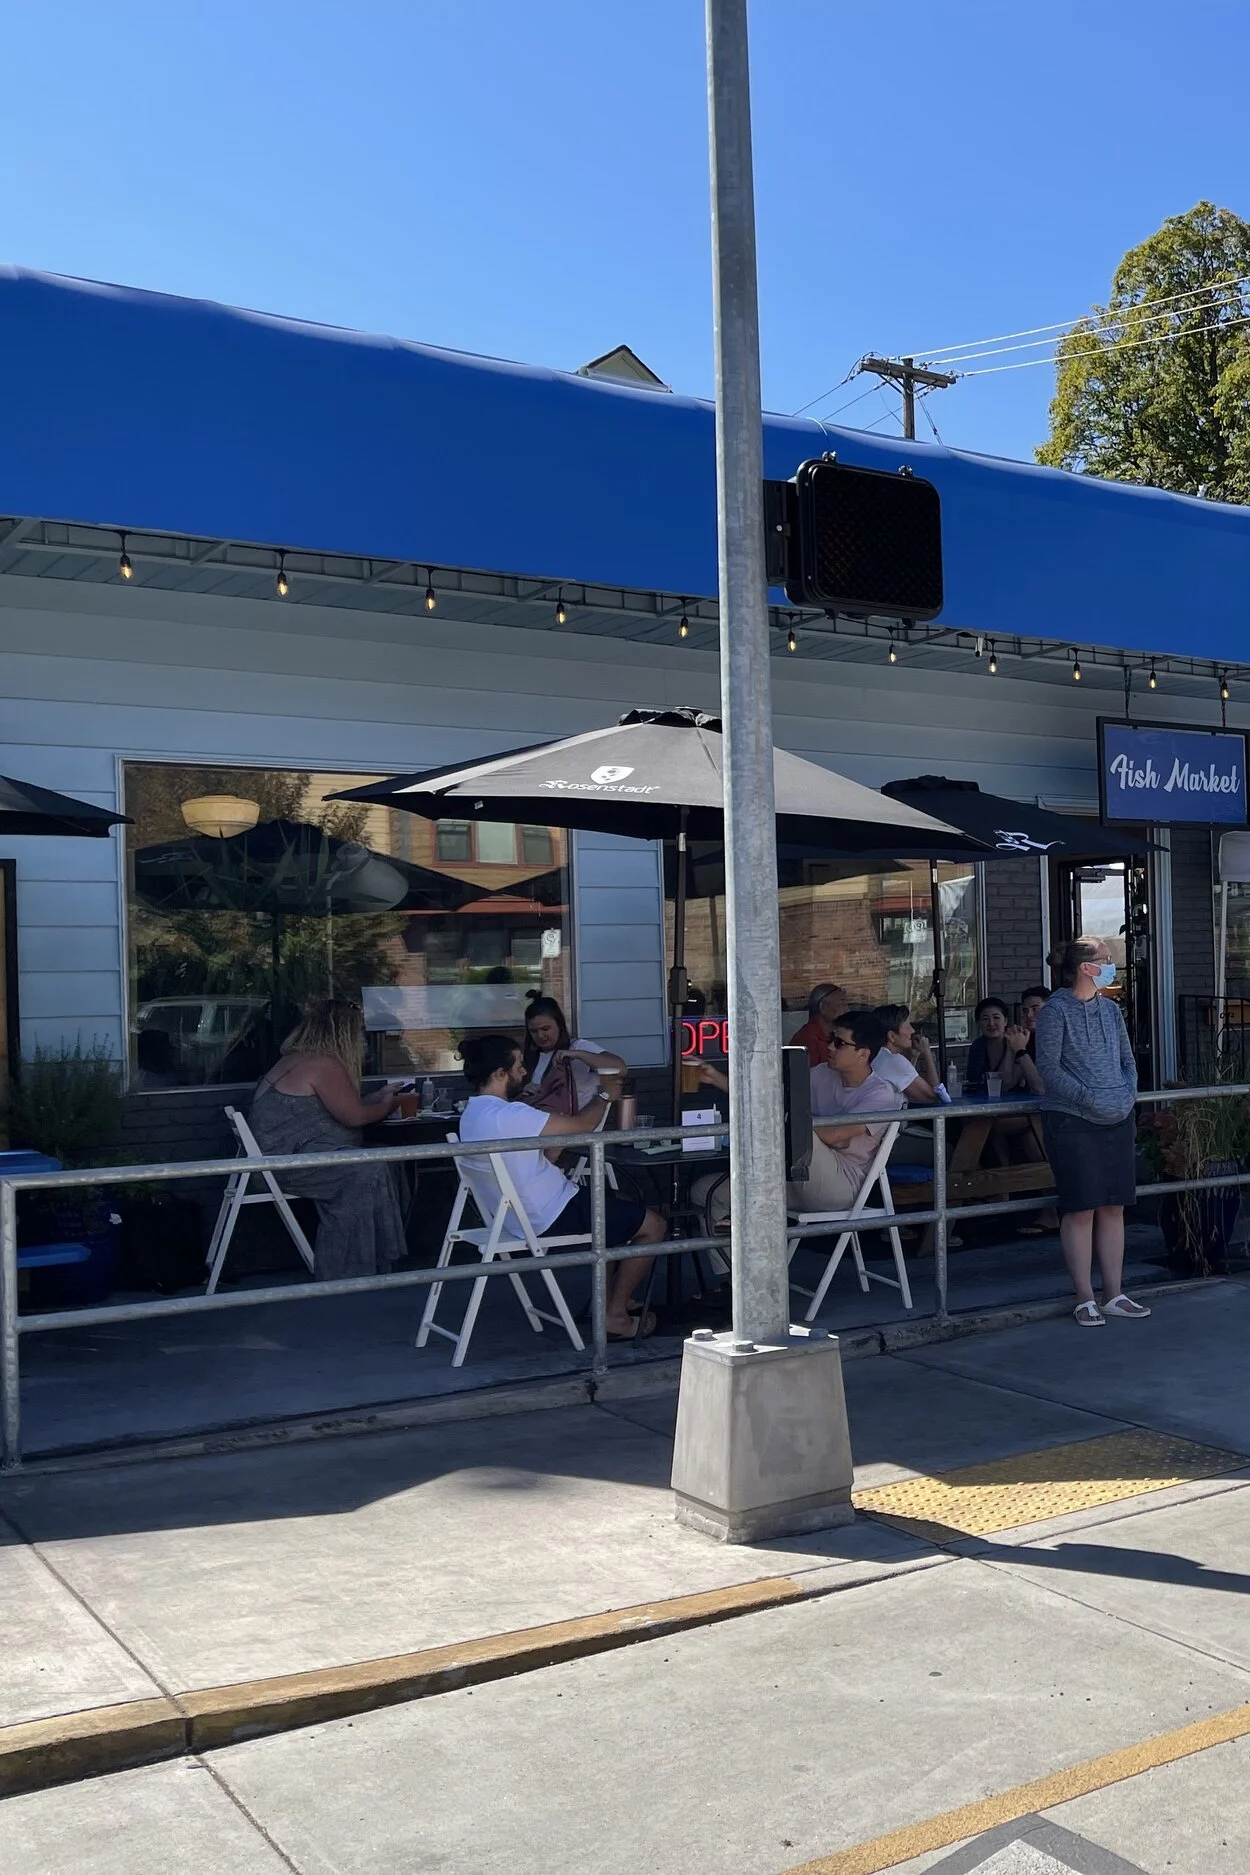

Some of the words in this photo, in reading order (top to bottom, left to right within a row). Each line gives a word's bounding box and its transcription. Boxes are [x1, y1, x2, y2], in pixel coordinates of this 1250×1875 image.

[538, 780, 661, 794] Rosenstadt
[1109, 753, 1161, 790] Fish
[1163, 757, 1241, 794] Market
